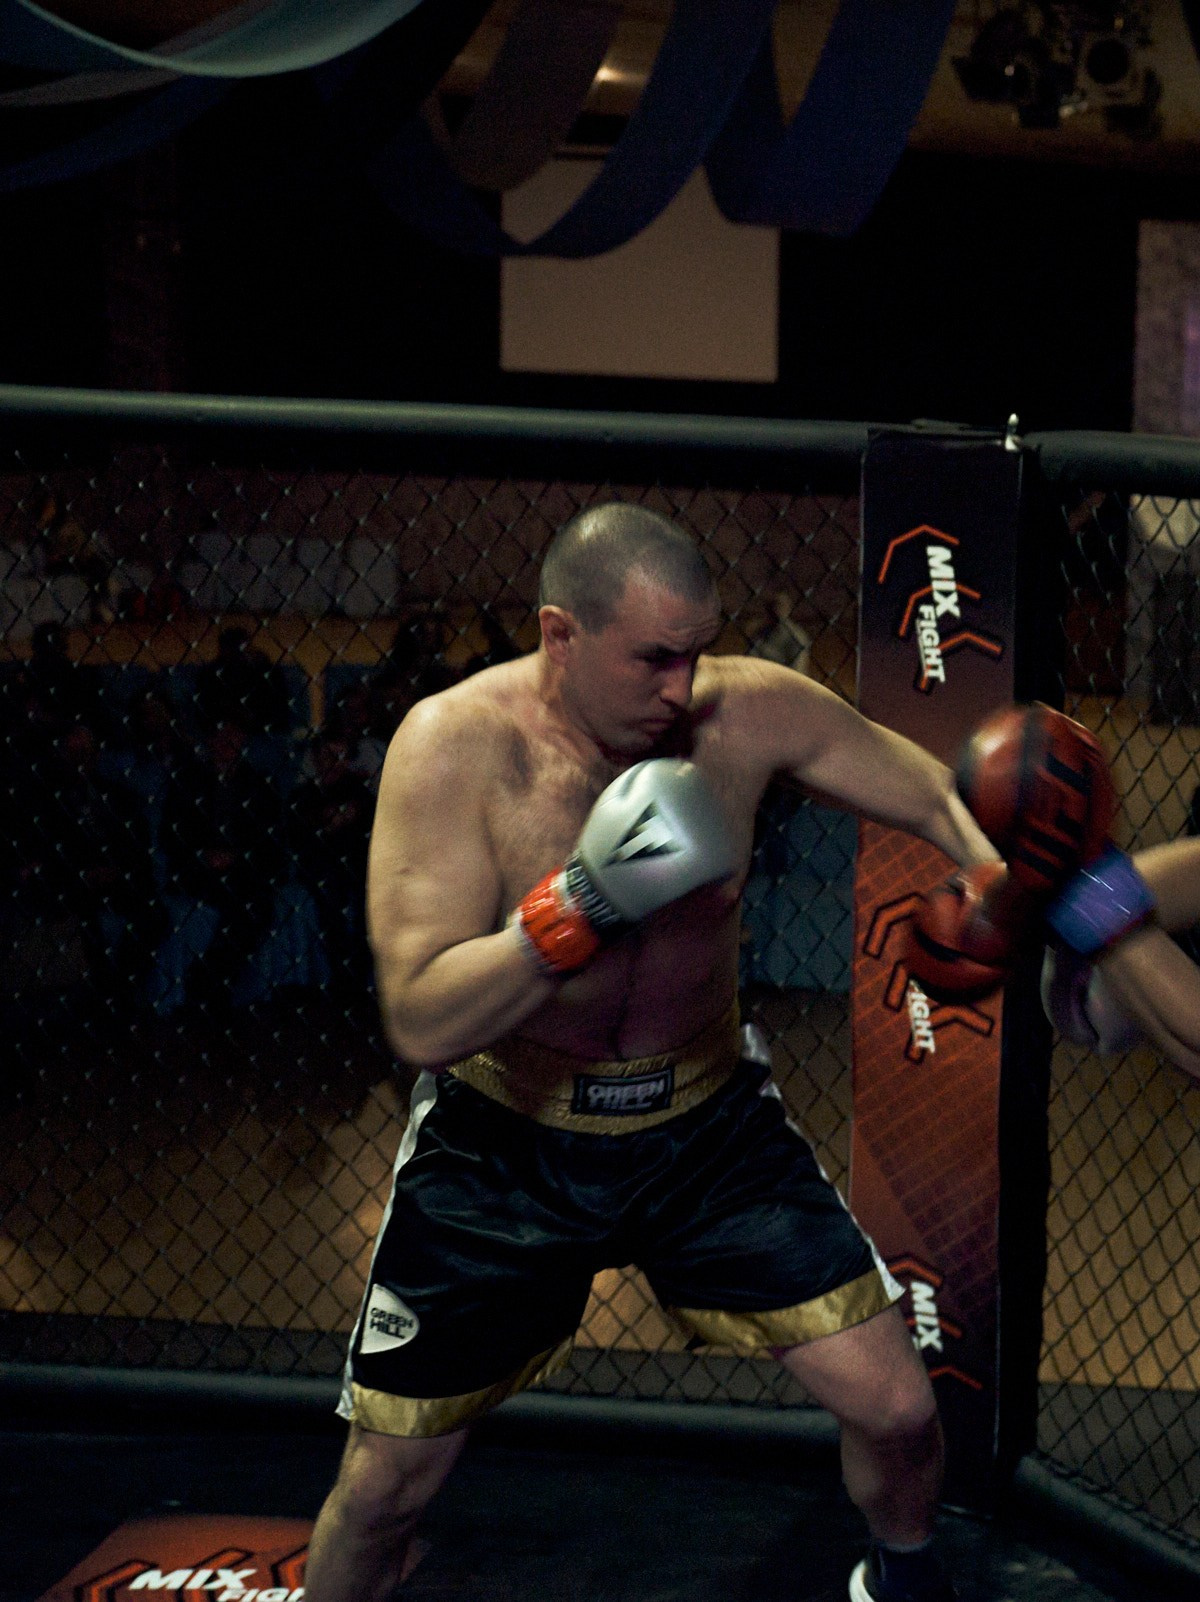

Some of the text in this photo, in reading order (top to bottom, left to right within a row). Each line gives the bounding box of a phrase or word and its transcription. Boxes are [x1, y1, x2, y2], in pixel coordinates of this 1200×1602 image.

[926, 545, 961, 619] MIX
[916, 604, 945, 683] FIGHT
[370, 1318, 405, 1339] HILL
[371, 1307, 413, 1328] GREEN
[910, 1280, 944, 1352] MIX
[128, 1568, 258, 1590] MIX
